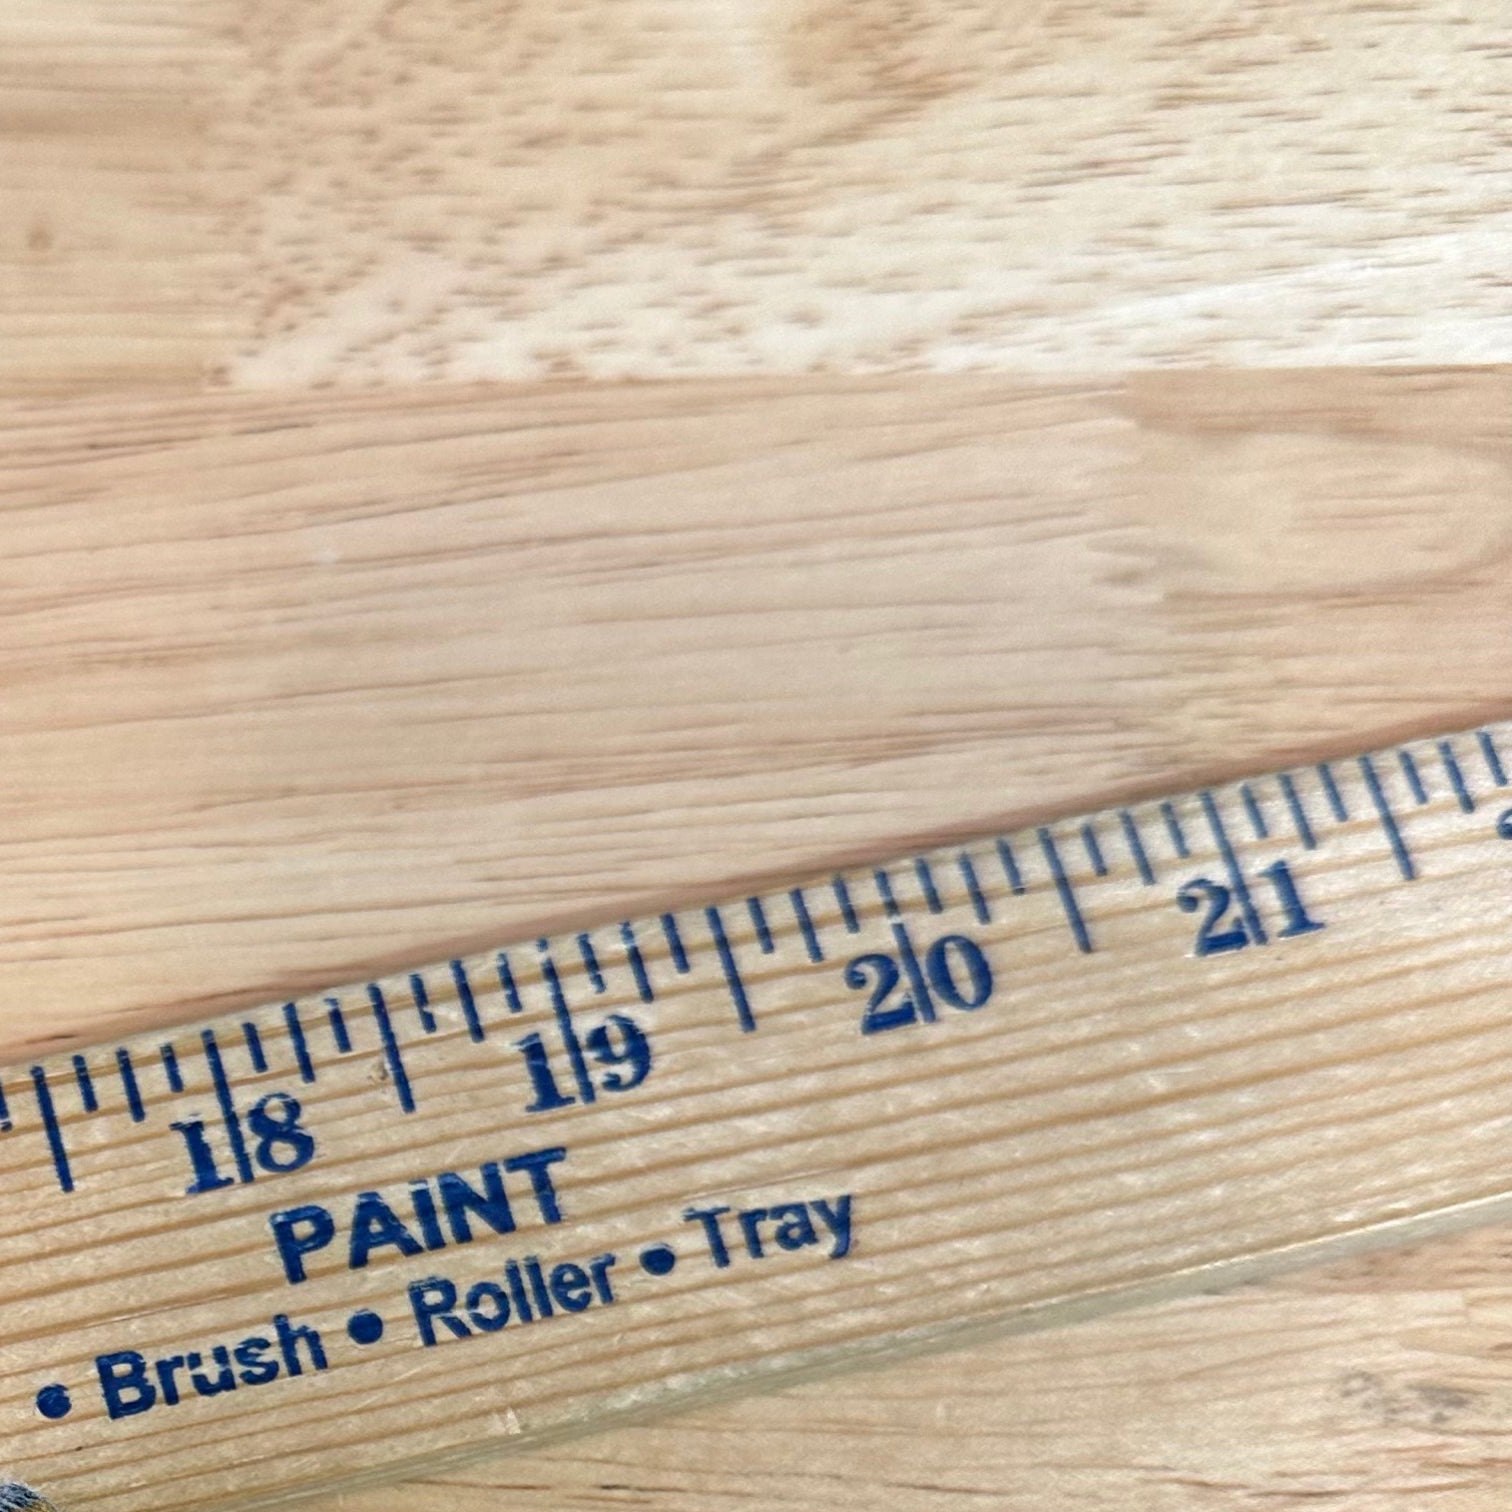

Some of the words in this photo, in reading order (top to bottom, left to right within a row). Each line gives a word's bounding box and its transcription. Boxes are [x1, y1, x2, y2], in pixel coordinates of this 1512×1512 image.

[170, 1093, 316, 1194] 18
[514, 1014, 653, 1111] 19
[845, 934, 993, 1034] 20
[1176, 860, 1324, 957] 21
[95, 1314, 328, 1420] Brush
[407, 1253, 616, 1347] Roller
[681, 1193, 853, 1269] Tray
[270, 1147, 568, 1283] PAINT
